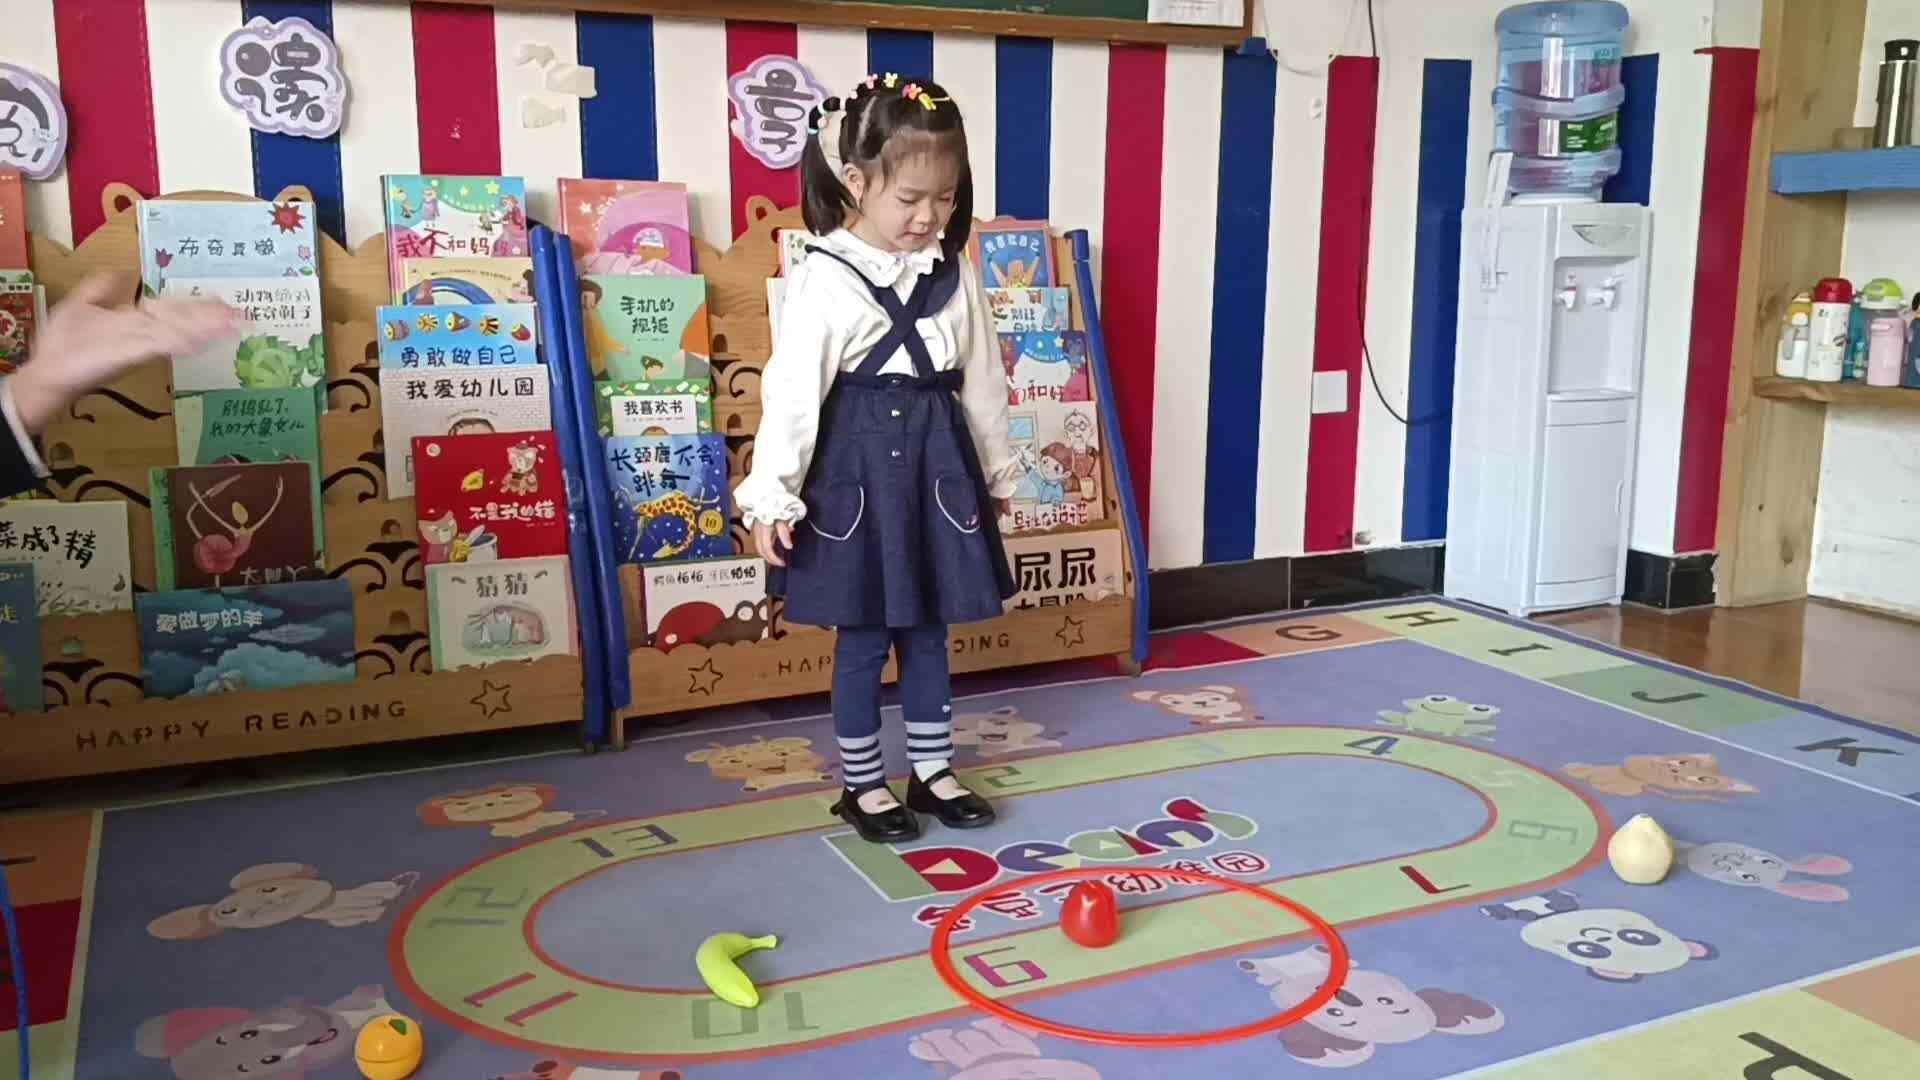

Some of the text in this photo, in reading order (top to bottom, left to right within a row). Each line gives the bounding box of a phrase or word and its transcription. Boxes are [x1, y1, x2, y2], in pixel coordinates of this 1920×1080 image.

[620, 296, 674, 316] 手机的
[631, 317, 669, 334] 规矩
[401, 345, 517, 368] 勇敢做自己
[406, 377, 534, 400] 我爱幼儿园
[624, 400, 683, 416] 我喜欢书
[610, 443, 715, 473] 长颈鹿不会
[1014, 547, 1096, 592] 尿尿
[476, 572, 528, 597] 猜猜
[1275, 624, 1342, 643] G
[77, 699, 406, 751] HAPPY READING
[1795, 736, 1904, 768] K
